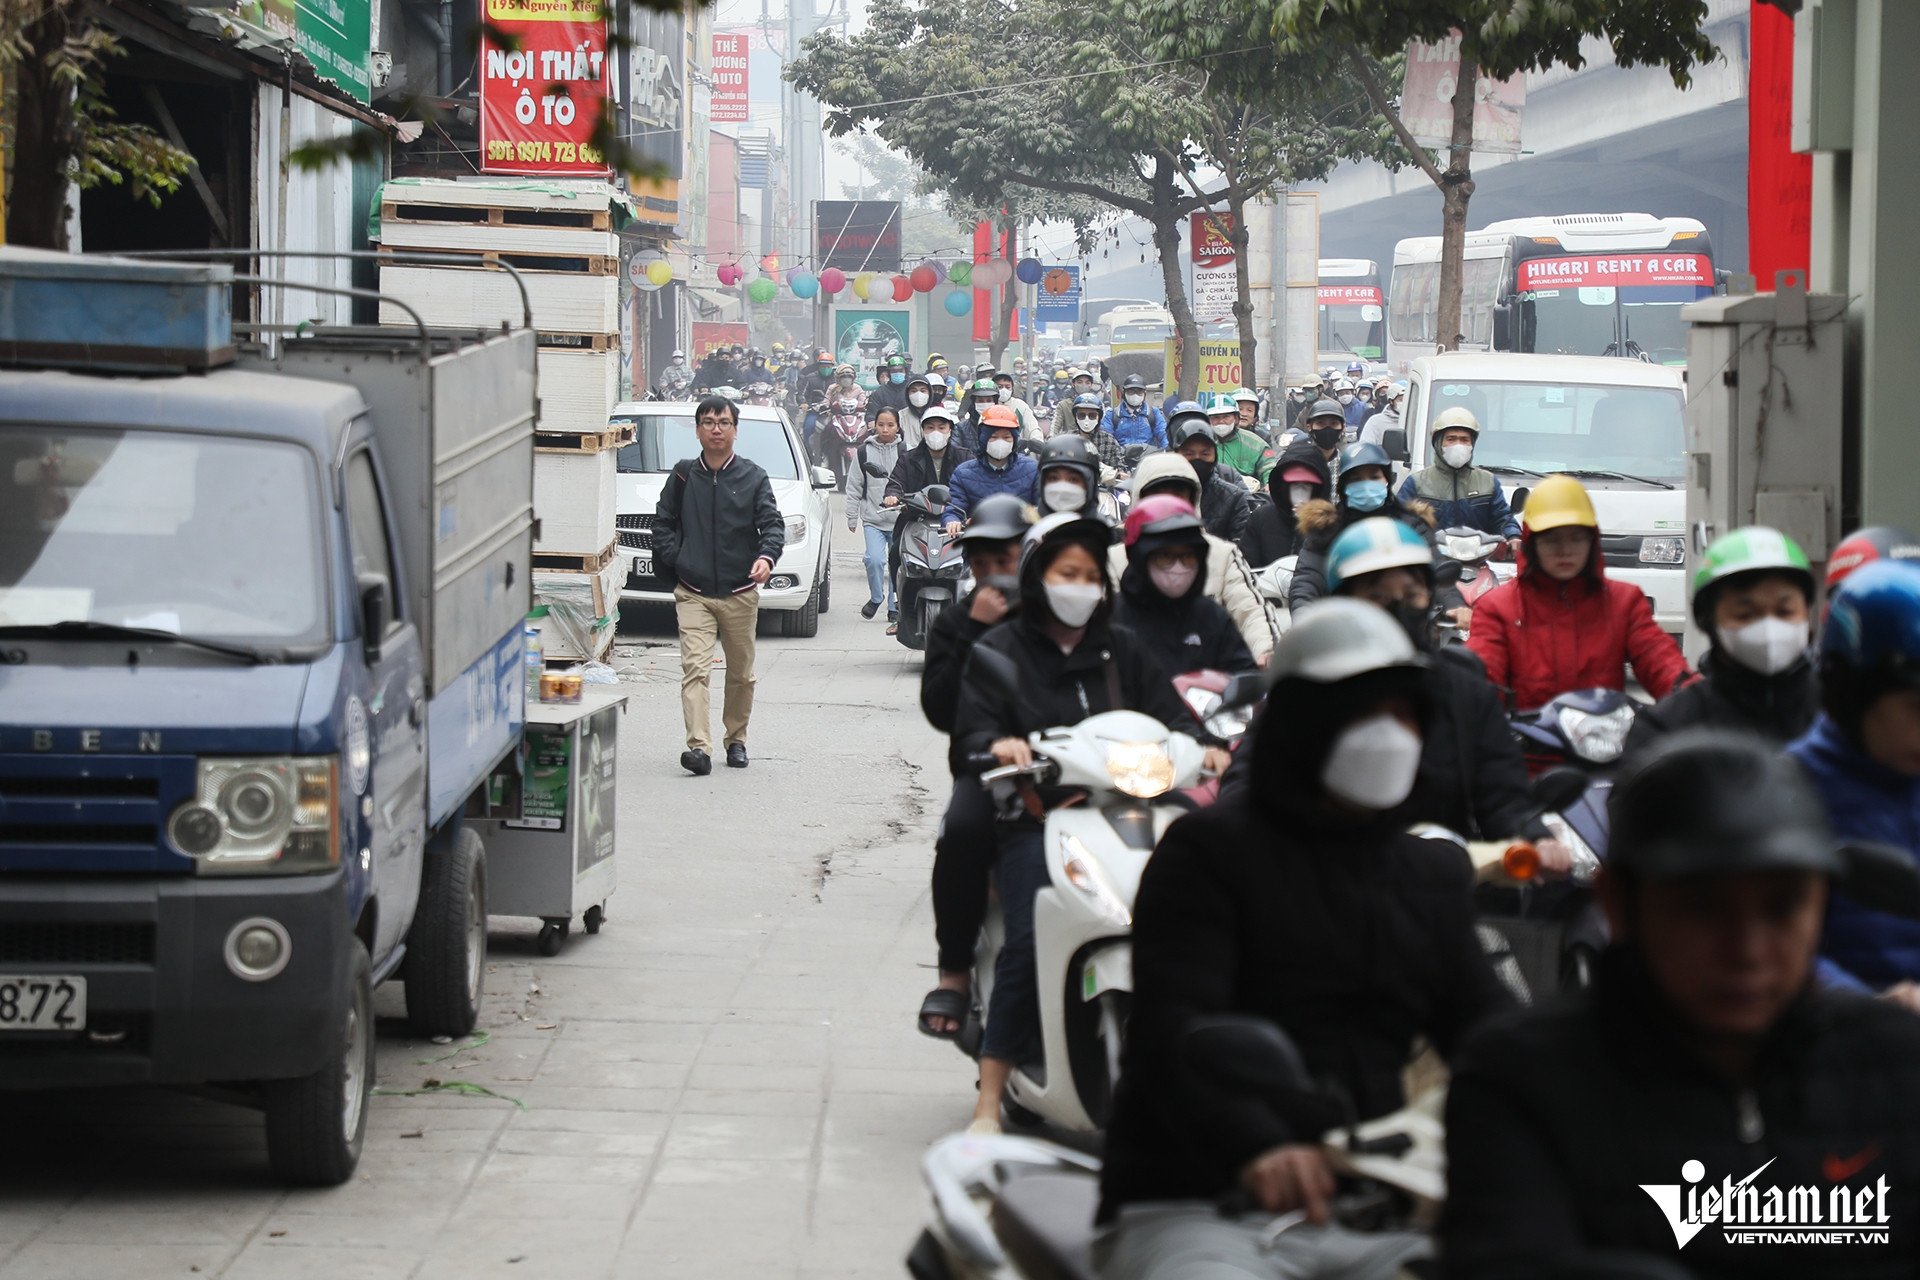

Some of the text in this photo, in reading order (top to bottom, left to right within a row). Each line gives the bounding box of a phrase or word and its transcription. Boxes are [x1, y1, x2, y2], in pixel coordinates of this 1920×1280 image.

[541, 40, 604, 80] THẤT
[712, 72, 742, 85] AUTO
[515, 88, 575, 125] Ô TÔ
[517, 141, 552, 162] 0974
[554, 142, 577, 163] 723
[1199, 246, 1236, 256] SAIGON
[1528, 258, 1698, 278] HIKARI RENT A CAR
[1317, 288, 1375, 298] RENT A CAR
[1200, 344, 1239, 357] GUYỄN XI
